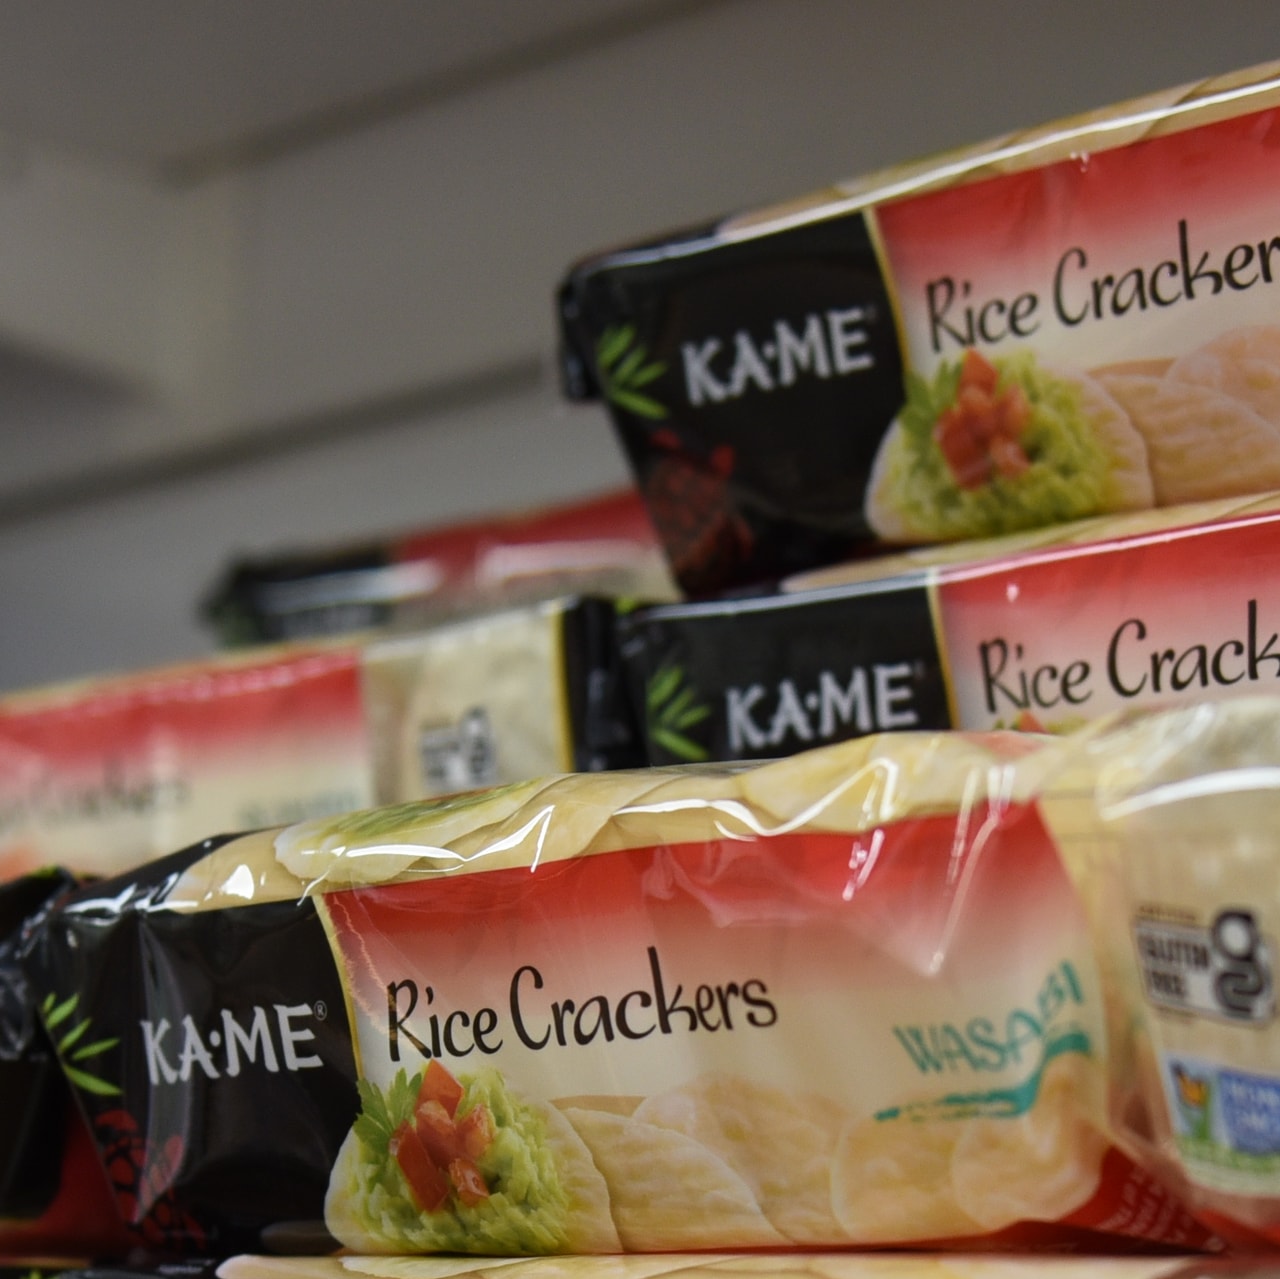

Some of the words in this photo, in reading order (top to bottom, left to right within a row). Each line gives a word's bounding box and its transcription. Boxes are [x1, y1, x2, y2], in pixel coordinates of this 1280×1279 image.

[924, 275, 1041, 355] Rice
[978, 636, 1093, 714] Rice
[386, 977, 504, 1063] Rice
[509, 945, 778, 1052] Crackers
[892, 960, 1084, 1075] WASABI
